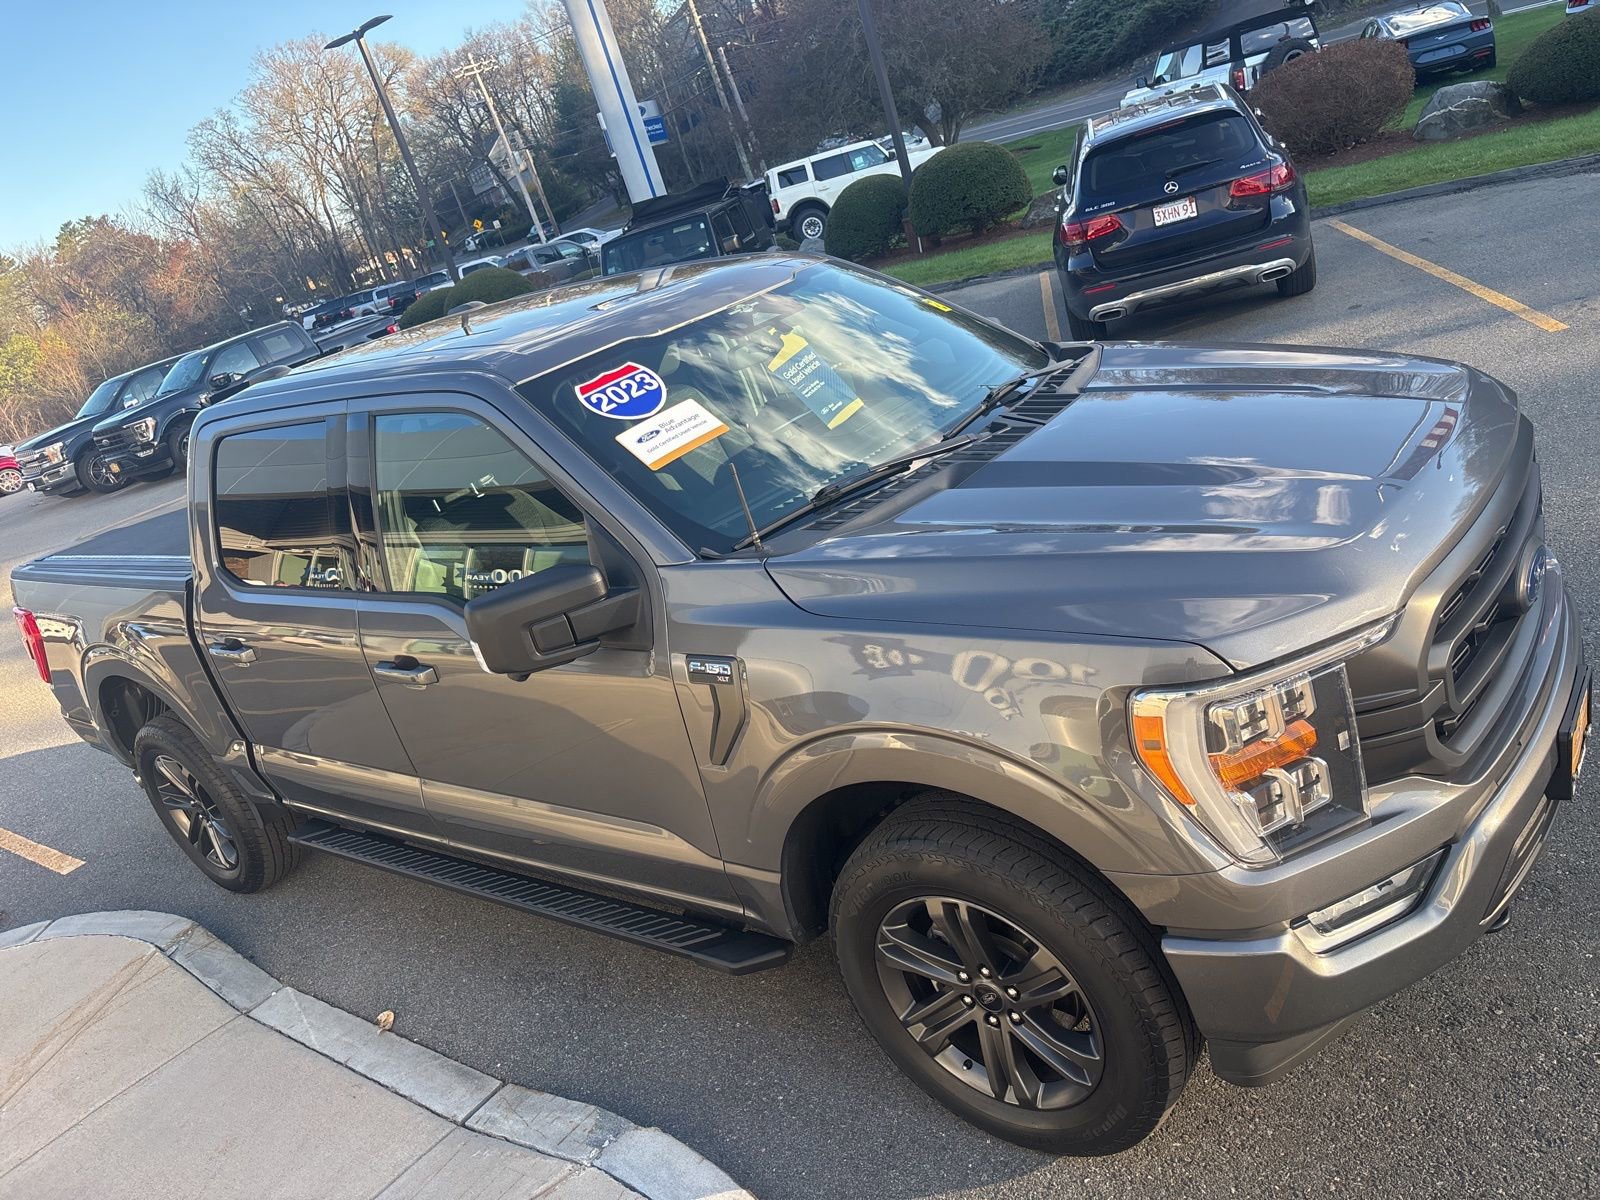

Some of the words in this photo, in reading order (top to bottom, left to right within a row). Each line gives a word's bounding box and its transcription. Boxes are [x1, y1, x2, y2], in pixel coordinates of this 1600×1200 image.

[1155, 206, 1180, 223] 3XHN
[783, 366, 797, 379] Gold
[795, 352, 817, 370] Certified
[788, 372, 805, 385] Used
[802, 360, 821, 376] Vehicle
[590, 373, 659, 413] 2023
[658, 419, 676, 429] Blue
[664, 414, 700, 433] Advantage
[638, 430, 660, 443] Ford
[688, 661, 731, 676] F-150
